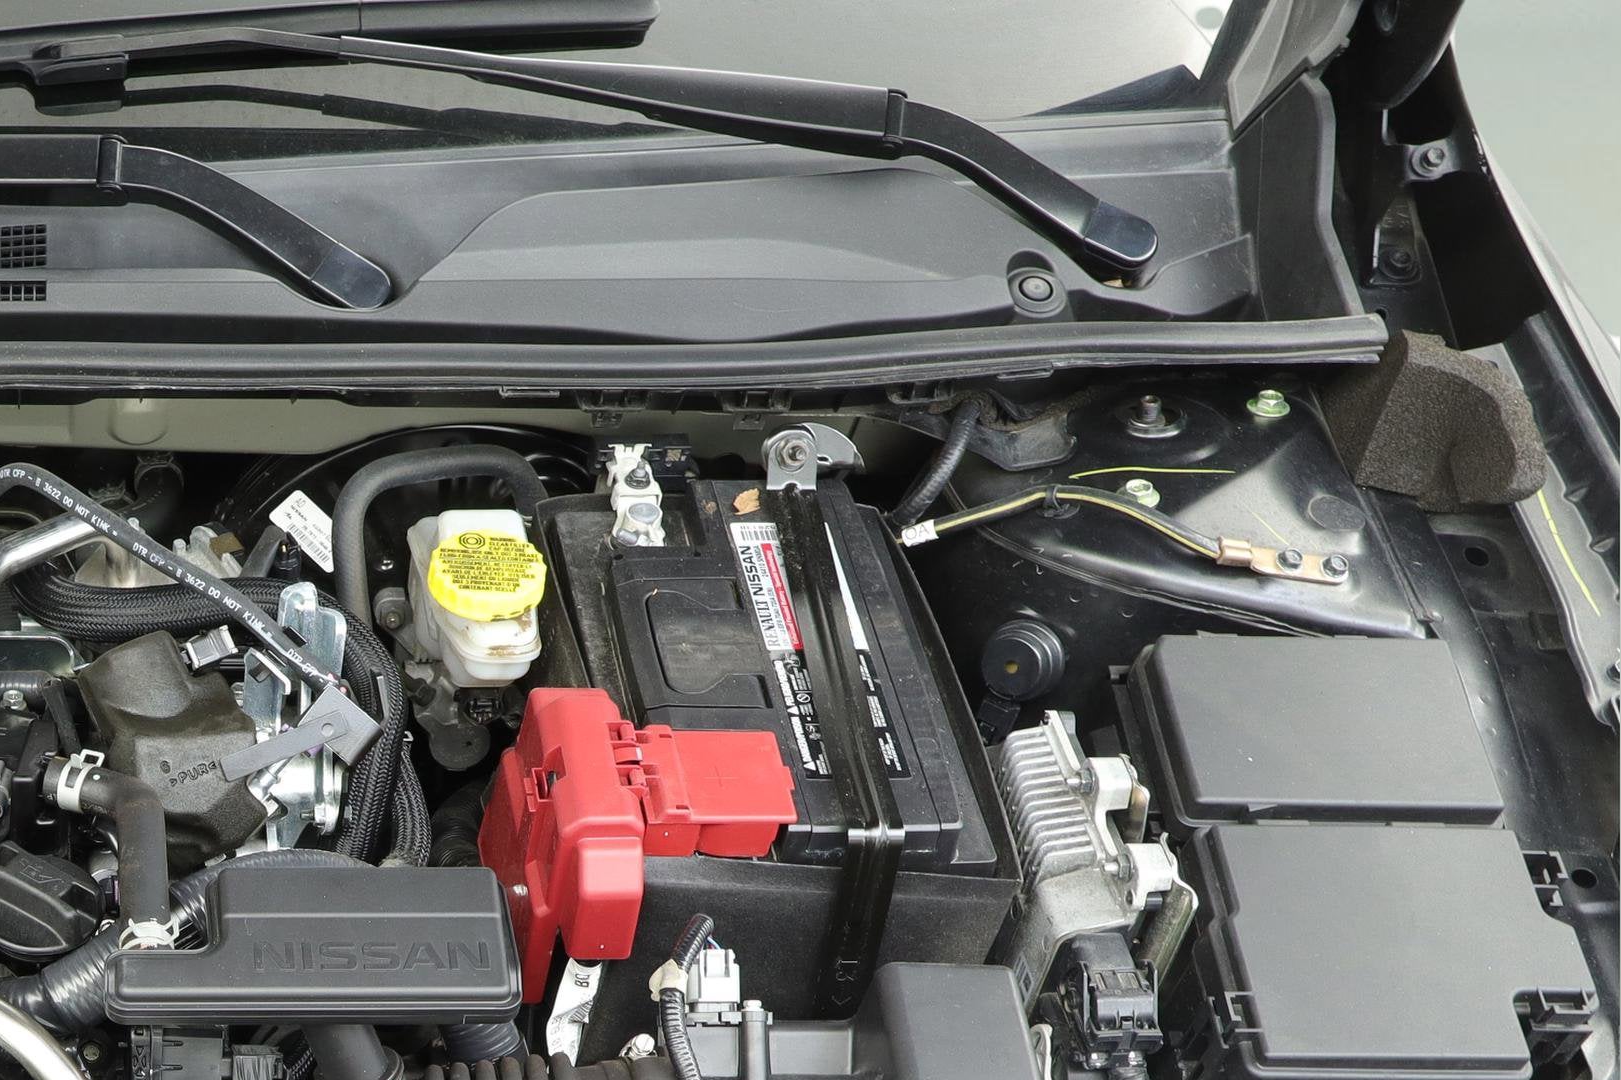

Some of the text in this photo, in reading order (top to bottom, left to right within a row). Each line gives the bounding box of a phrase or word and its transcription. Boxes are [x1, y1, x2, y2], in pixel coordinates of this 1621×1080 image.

[74, 503, 90, 518] NOT
[90, 513, 111, 534] KINK
[739, 545, 765, 596] NISSAN
[184, 573, 206, 591] 3622
[207, 586, 220, 599] DO
[222, 594, 242, 612] NOT
[755, 600, 781, 647] RENAULT
[253, 941, 492, 971] NISSAN
